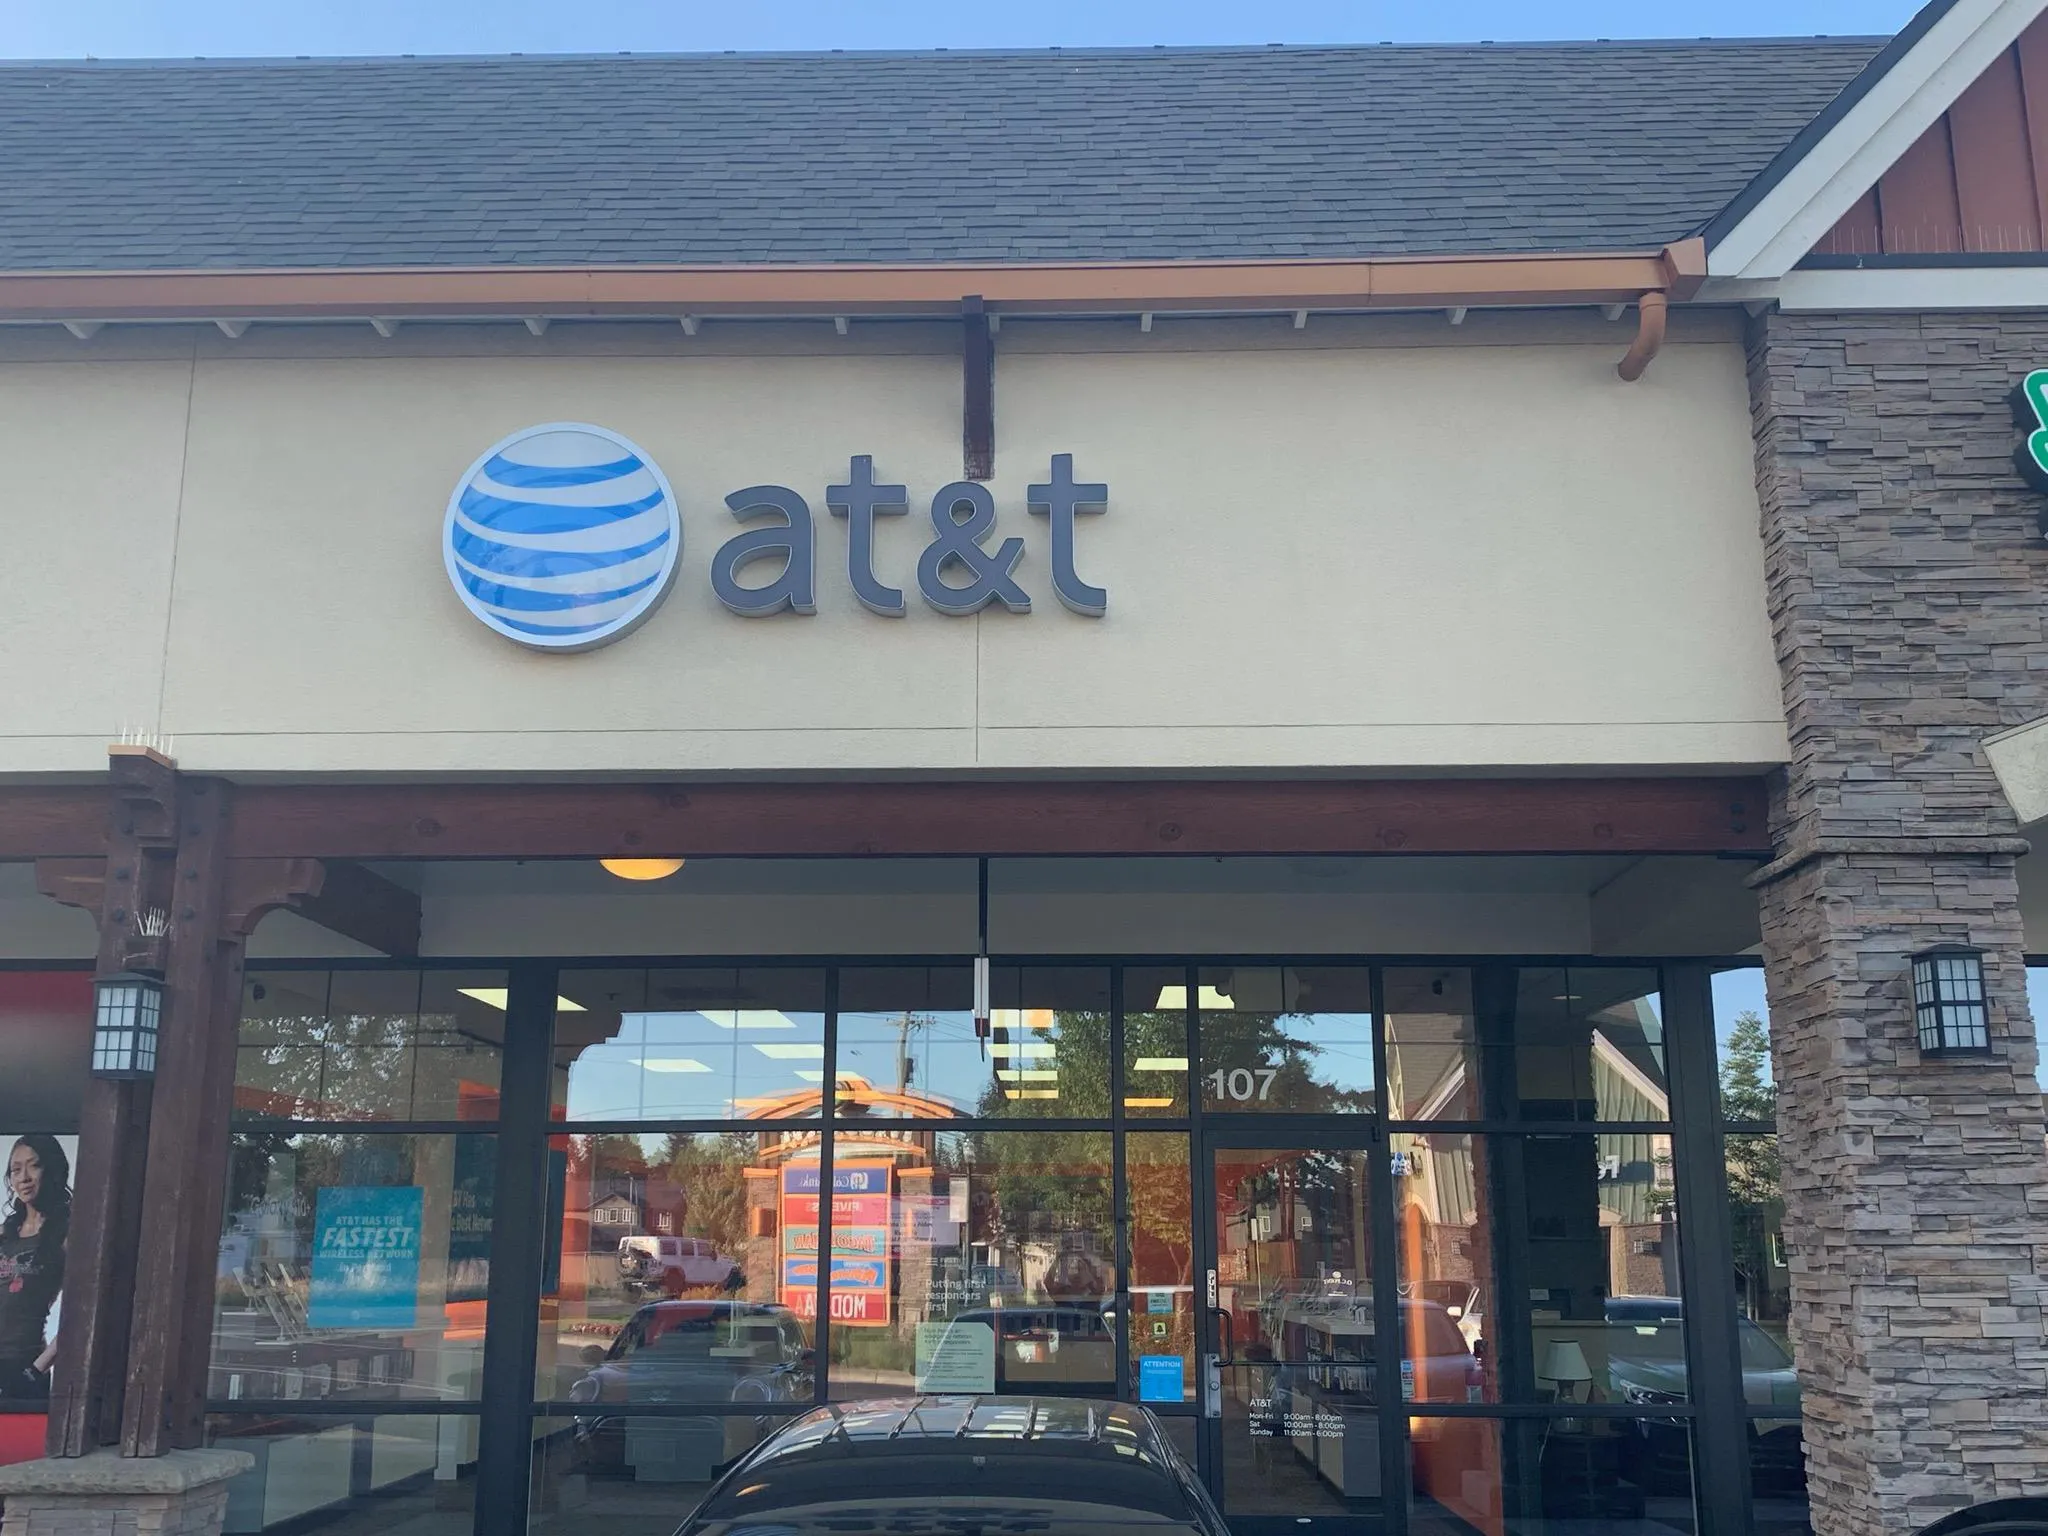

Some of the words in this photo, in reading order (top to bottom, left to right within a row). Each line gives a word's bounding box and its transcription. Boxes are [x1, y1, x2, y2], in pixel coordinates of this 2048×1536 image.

[710, 453, 1108, 618] at&t
[1208, 1068, 1277, 1101] 107
[321, 1227, 414, 1248] FASTEST
[319, 1248, 365, 1259] WIRELESS
[964, 1279, 985, 1289] first
[926, 1291, 981, 1302] responders
[1143, 1360, 1181, 1368] ATTENTION
[1249, 1398, 1273, 1408] AT&T
[1249, 1412, 1274, 1420] Mon-Fri
[1283, 1413, 1311, 1421] 9:00am
[1315, 1414, 1343, 1422] 8:00pm
[1249, 1420, 1261, 1428] Sat
[1283, 1421, 1314, 1429] 10:00am
[1249, 1428, 1274, 1437] Sunday
[1283, 1429, 1312, 1437] 11:00am
